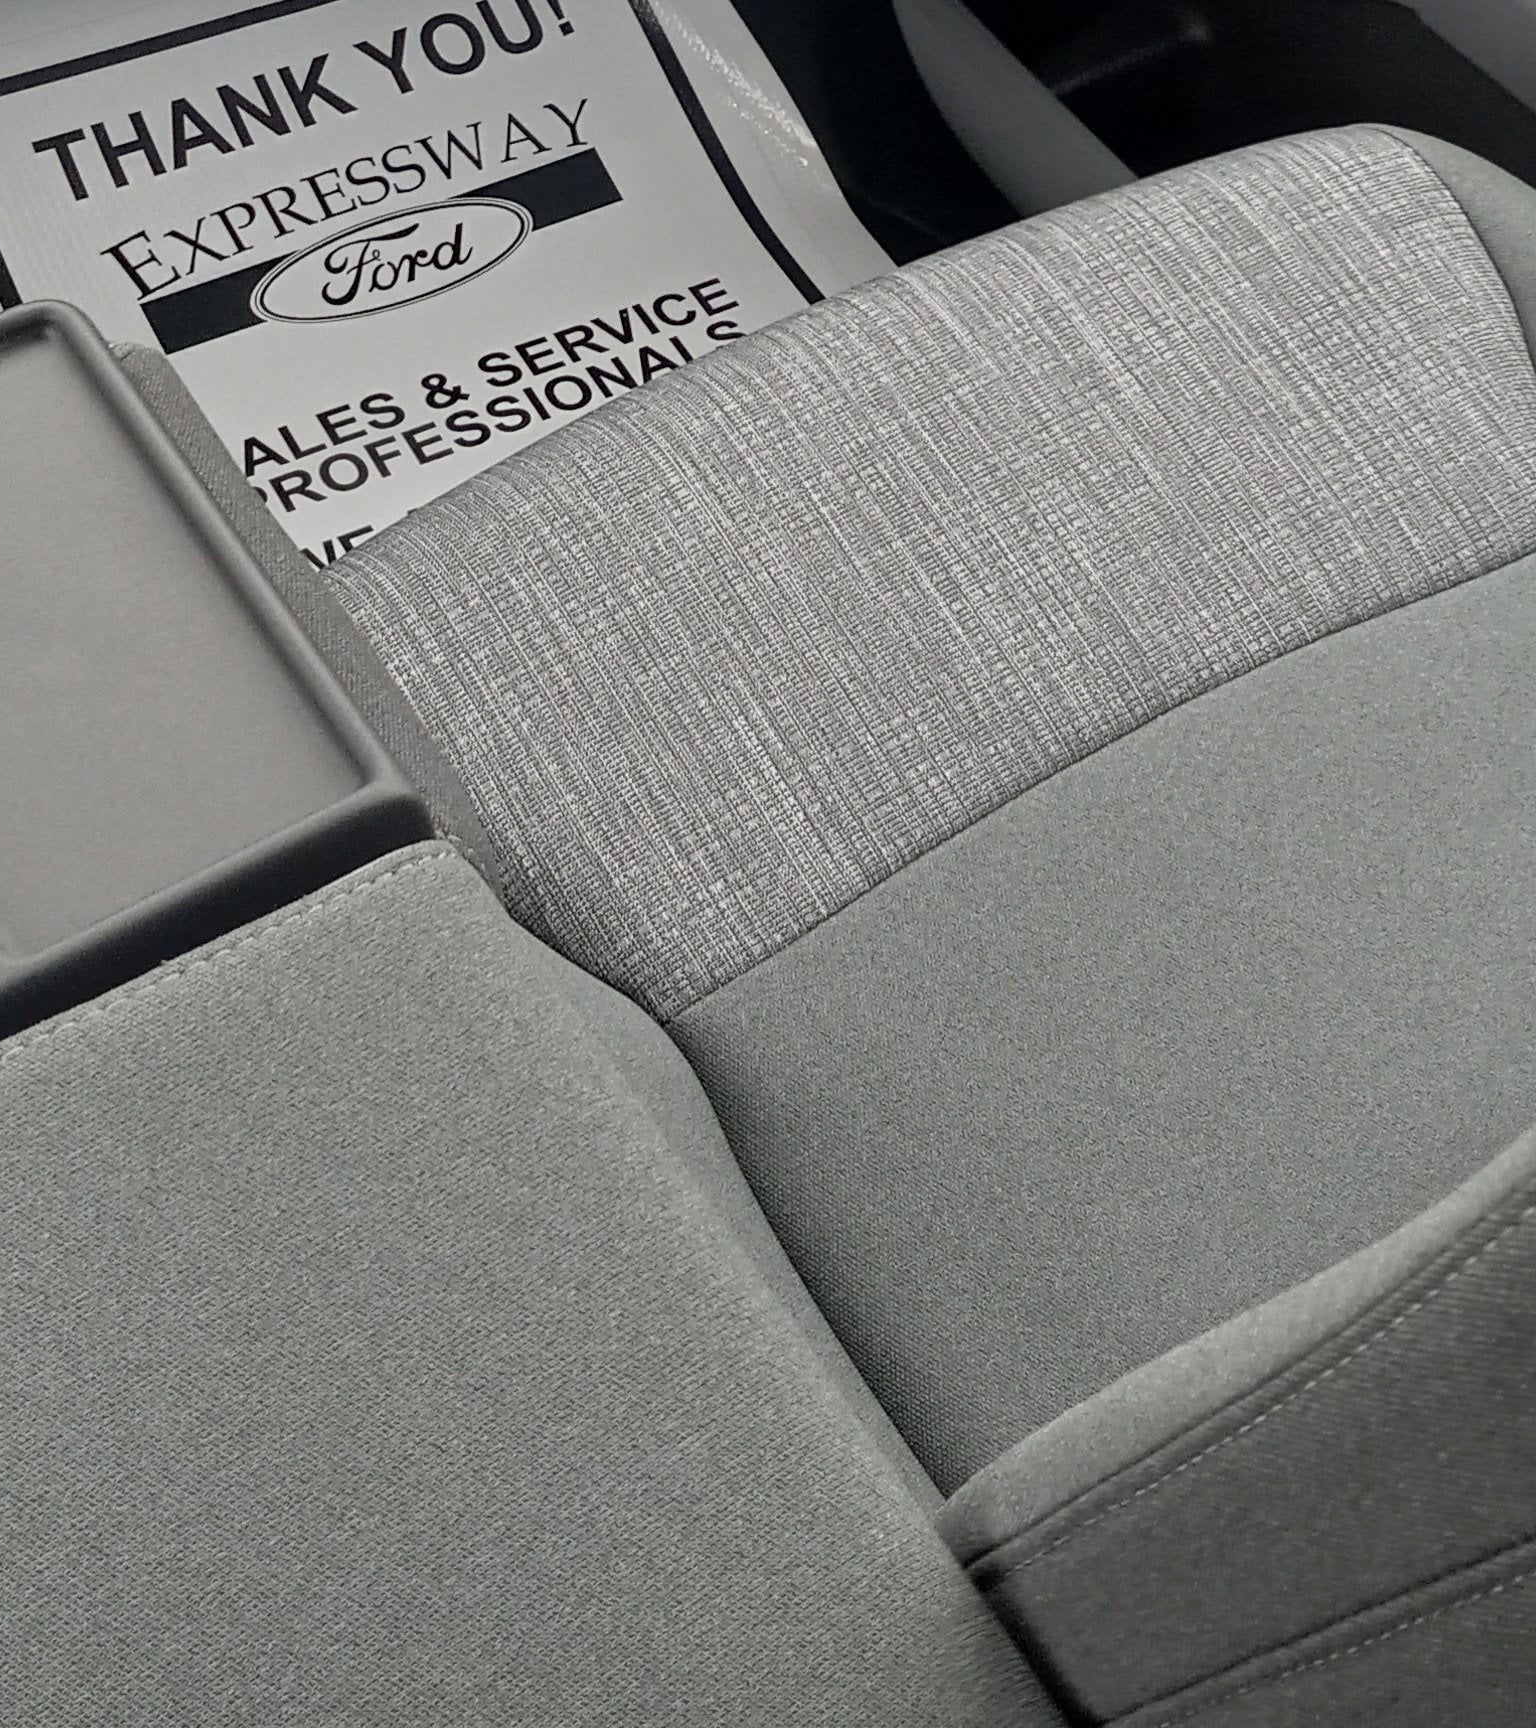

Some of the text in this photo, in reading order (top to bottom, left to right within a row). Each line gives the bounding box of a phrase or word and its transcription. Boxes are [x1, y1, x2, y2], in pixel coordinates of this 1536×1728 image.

[32, 53, 358, 202] THANK
[101, 99, 595, 300] EXPRESSWAY
[321, 222, 474, 307] Ford
[244, 277, 740, 478] ALES & SERVICE
